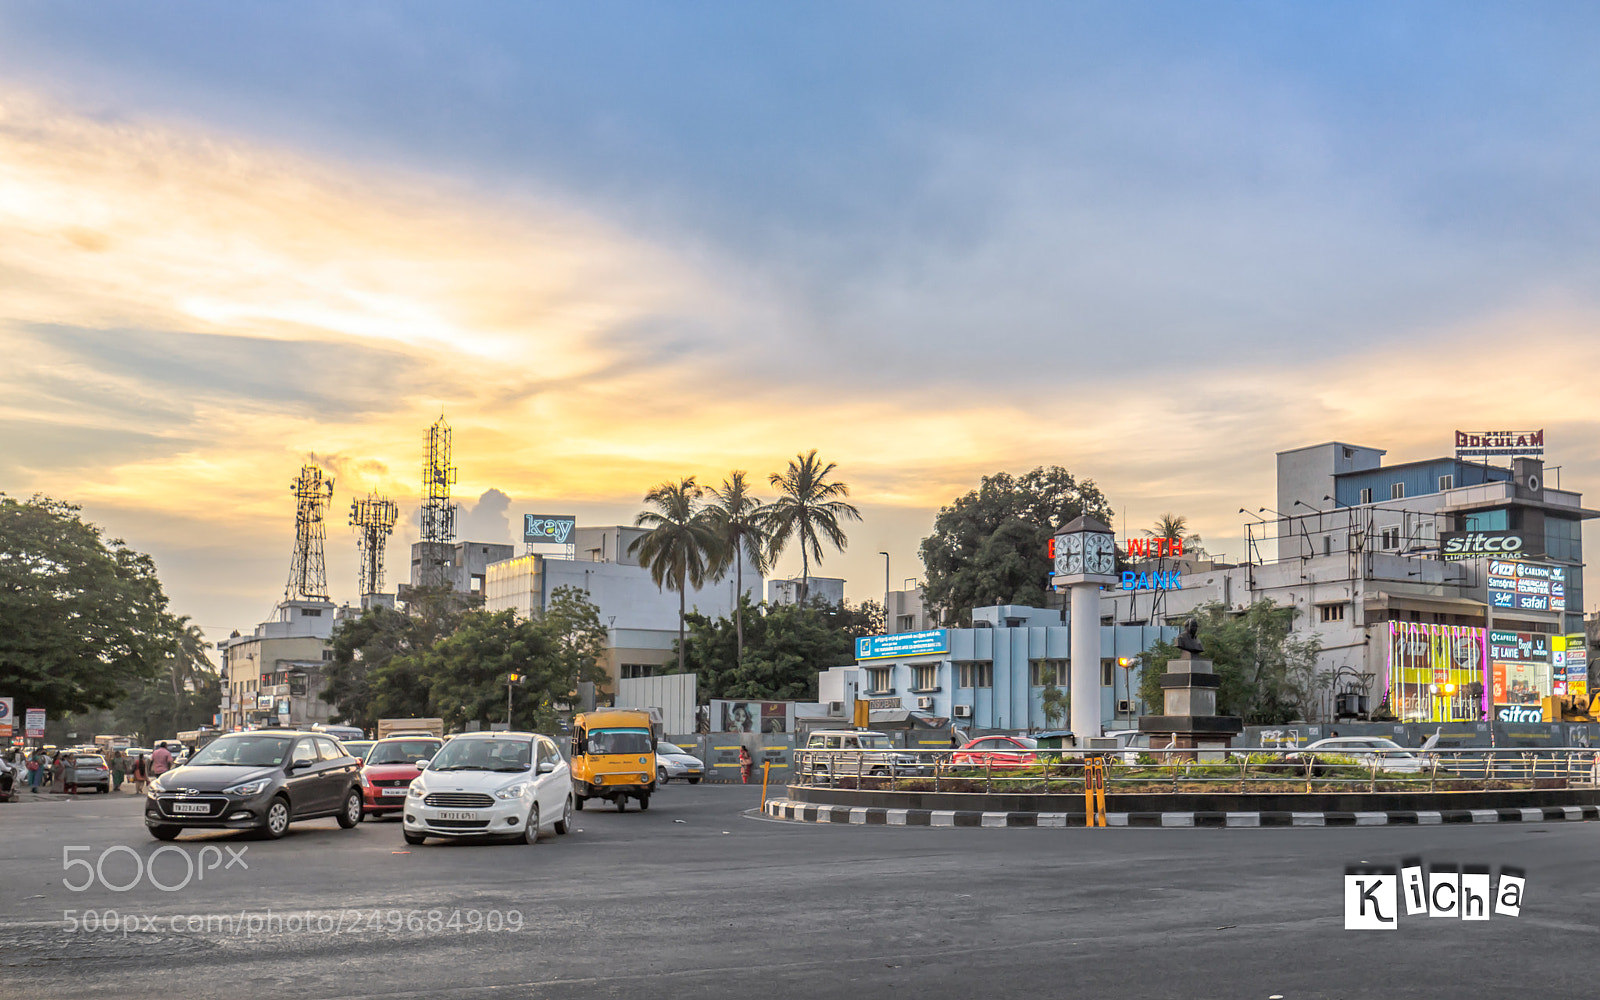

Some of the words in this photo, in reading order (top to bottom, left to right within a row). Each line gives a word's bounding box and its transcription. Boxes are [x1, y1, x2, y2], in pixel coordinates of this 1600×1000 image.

[1455, 428, 1544, 447] GOKULAM
[526, 514, 574, 543] kay
[1127, 538, 1183, 558] WITH
[1444, 533, 1522, 552] sitco
[1122, 571, 1182, 591] BANK
[1524, 566, 1549, 577] CARLTON
[1521, 595, 1547, 609] safari
[1499, 706, 1542, 723] sitco
